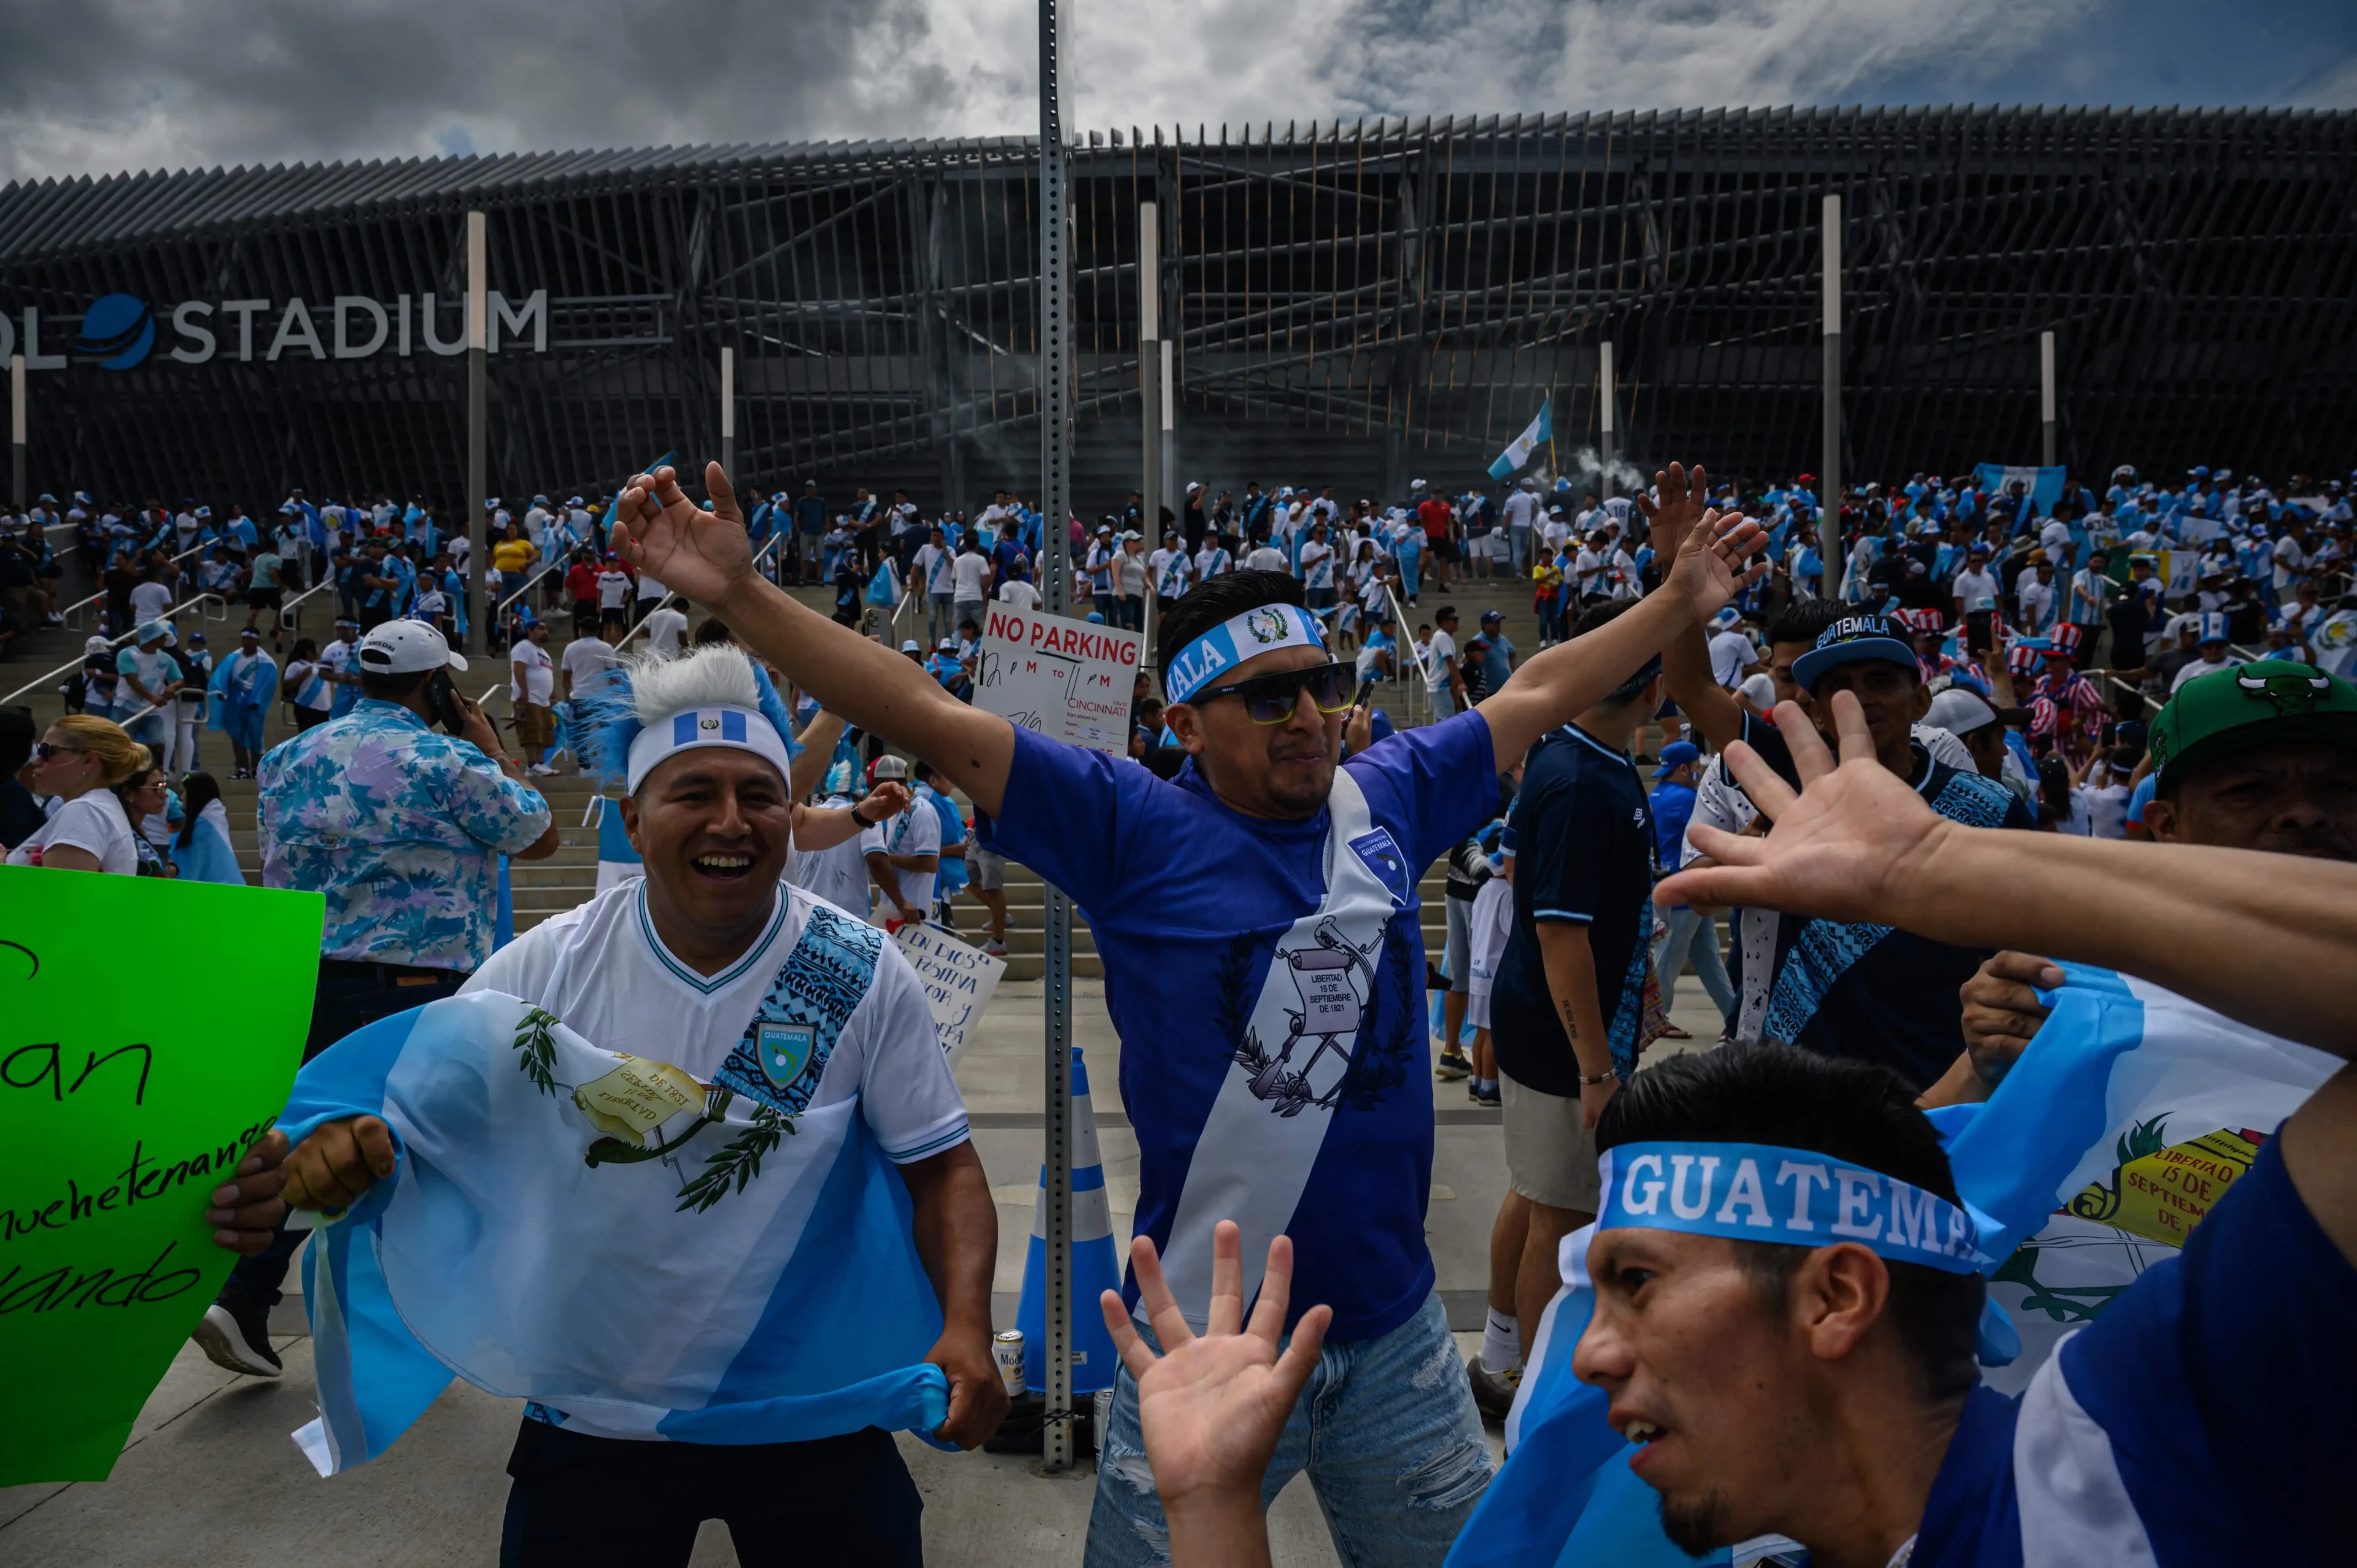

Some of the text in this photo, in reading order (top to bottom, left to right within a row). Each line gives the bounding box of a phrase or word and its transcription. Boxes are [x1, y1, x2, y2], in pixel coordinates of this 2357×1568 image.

[170, 289, 548, 363] STADIUM
[988, 612, 1136, 665] NO PARKING
[1817, 616, 1890, 649] GUATEMALA
[1052, 670, 1064, 678] TO
[1068, 698, 1126, 717] CINCINNATI
[1361, 840, 1392, 856] GUATEMALA
[934, 943, 975, 970] DIOS
[915, 956, 977, 994] POSITIVA
[1311, 973, 1342, 983] LIBERTAD
[1309, 993, 1352, 1004] SEPTIEMBRE
[1320, 984, 1339, 993] 15 DE
[1330, 1003, 1345, 1013] 1821
[764, 1031, 807, 1042] GUATEMALA
[2153, 1149, 2233, 1183] LIBERTAD
[2161, 1165, 2212, 1202] 15 DE
[2158, 1208, 2181, 1232] DE
